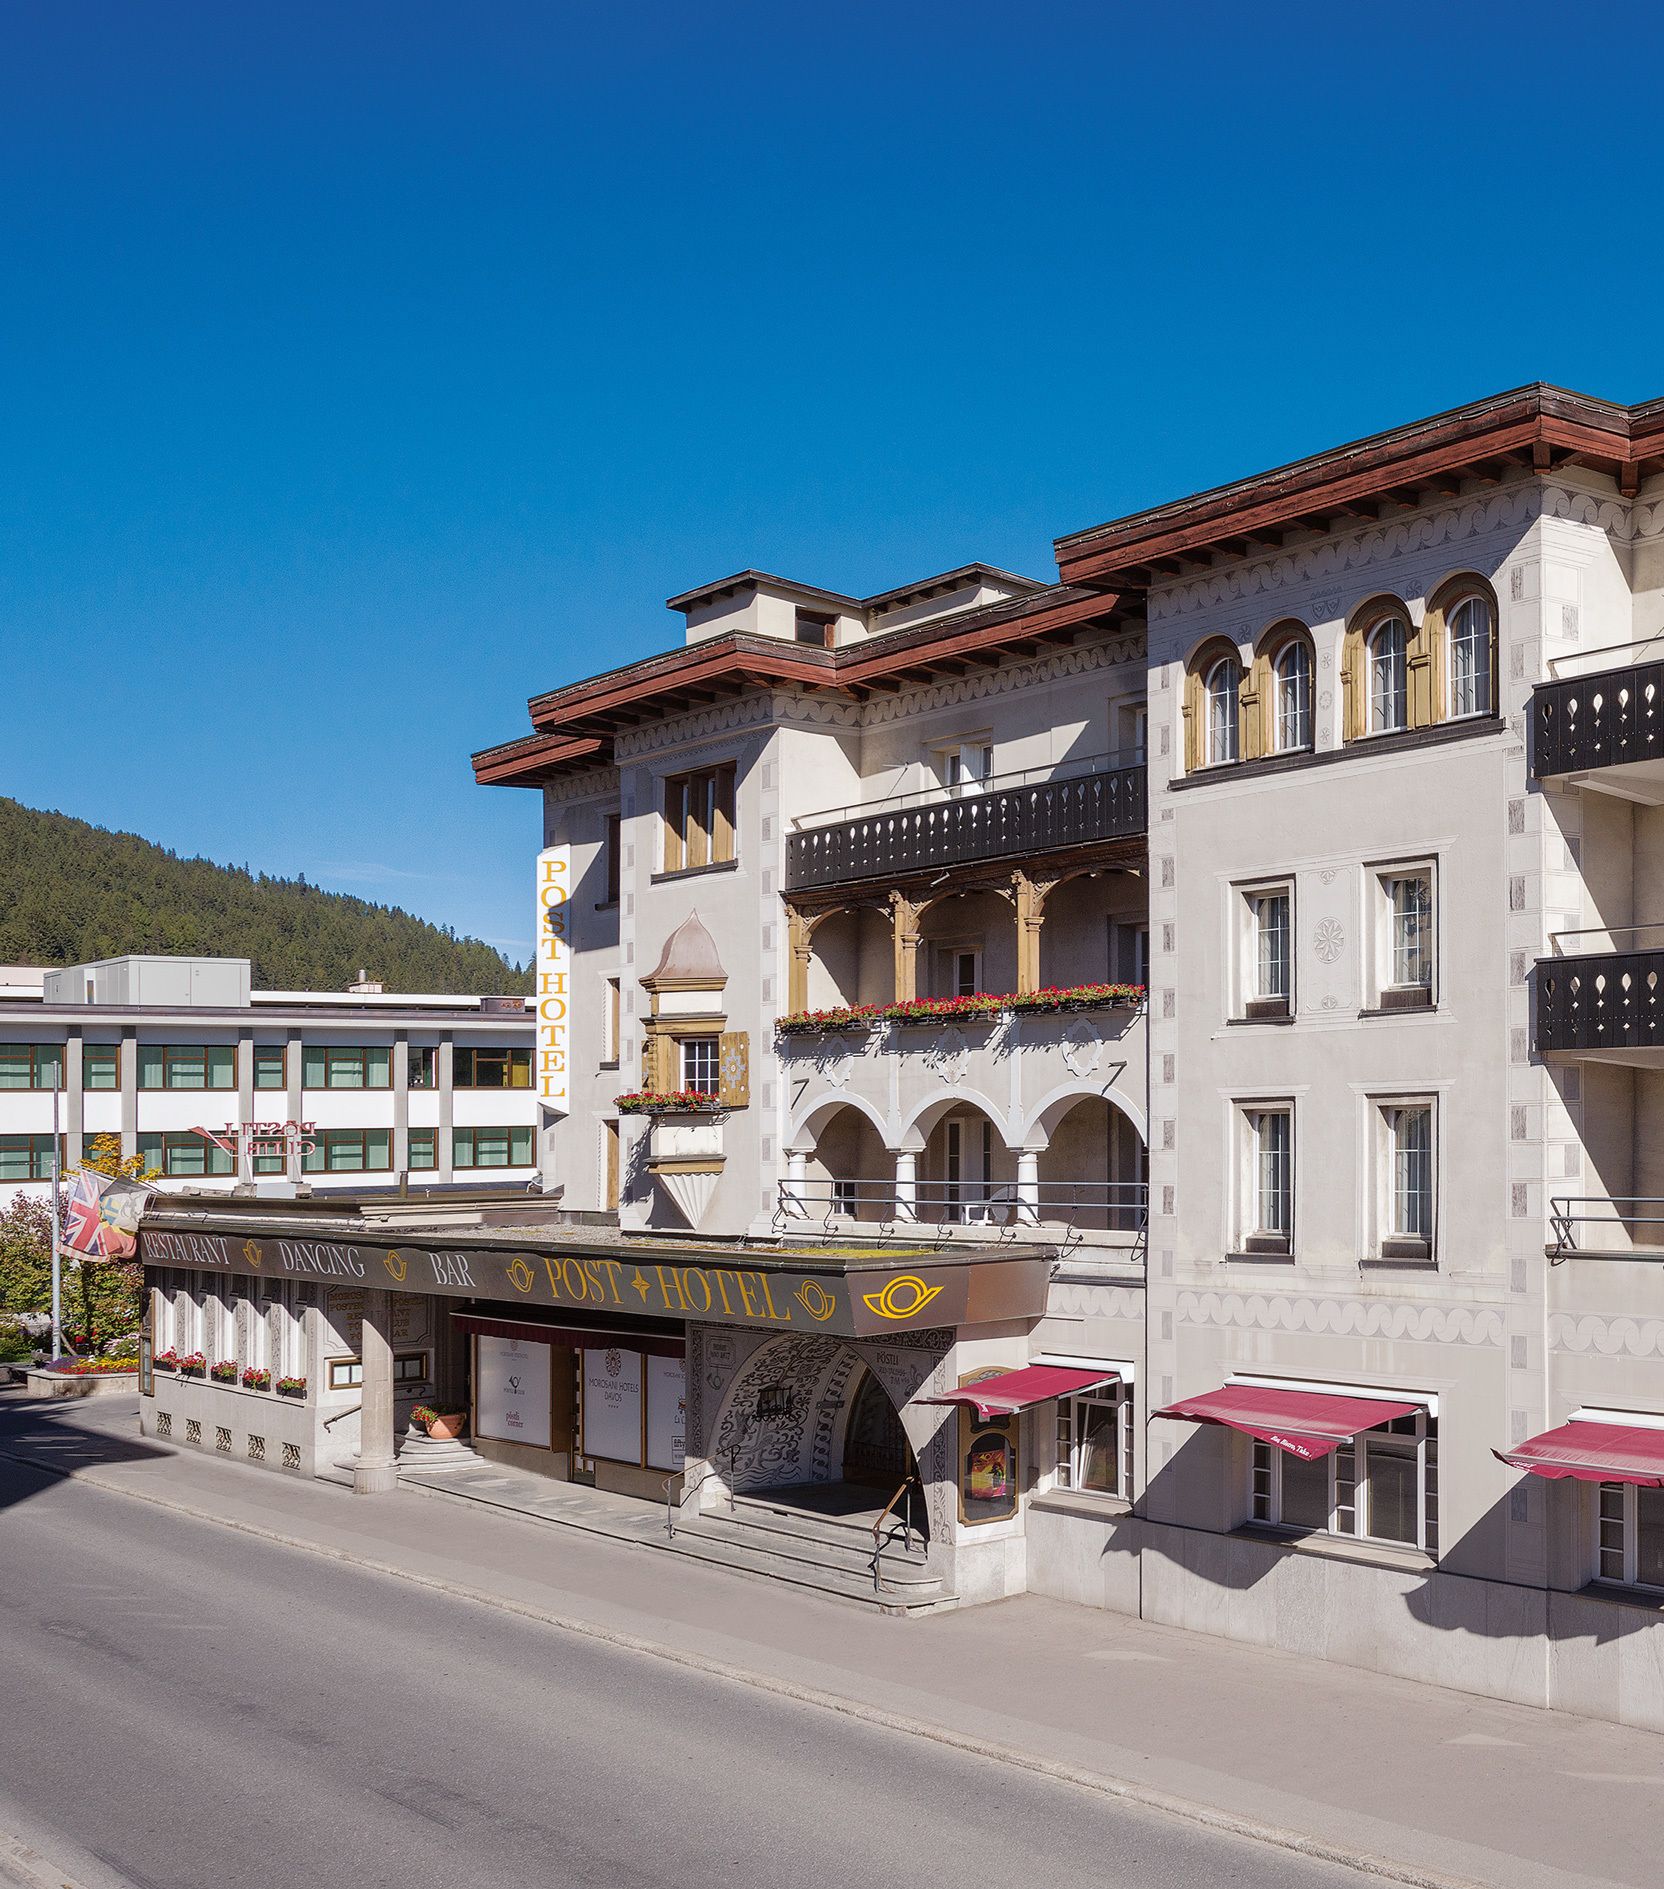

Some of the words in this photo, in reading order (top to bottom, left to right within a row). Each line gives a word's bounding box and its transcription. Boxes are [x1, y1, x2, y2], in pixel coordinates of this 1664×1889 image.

[540, 860, 567, 960] POST
[539, 972, 568, 1098] HOTEL
[142, 1232, 230, 1265] RESTAURANT
[278, 1242, 365, 1278] DANCING
[429, 1252, 476, 1287] BAR
[544, 1257, 624, 1304] POST
[655, 1265, 791, 1321] HOTEL
[588, 1378, 618, 1391] MOROSANI
[619, 1381, 639, 1393] HOTELS
[603, 1391, 622, 1402] DAVOS
